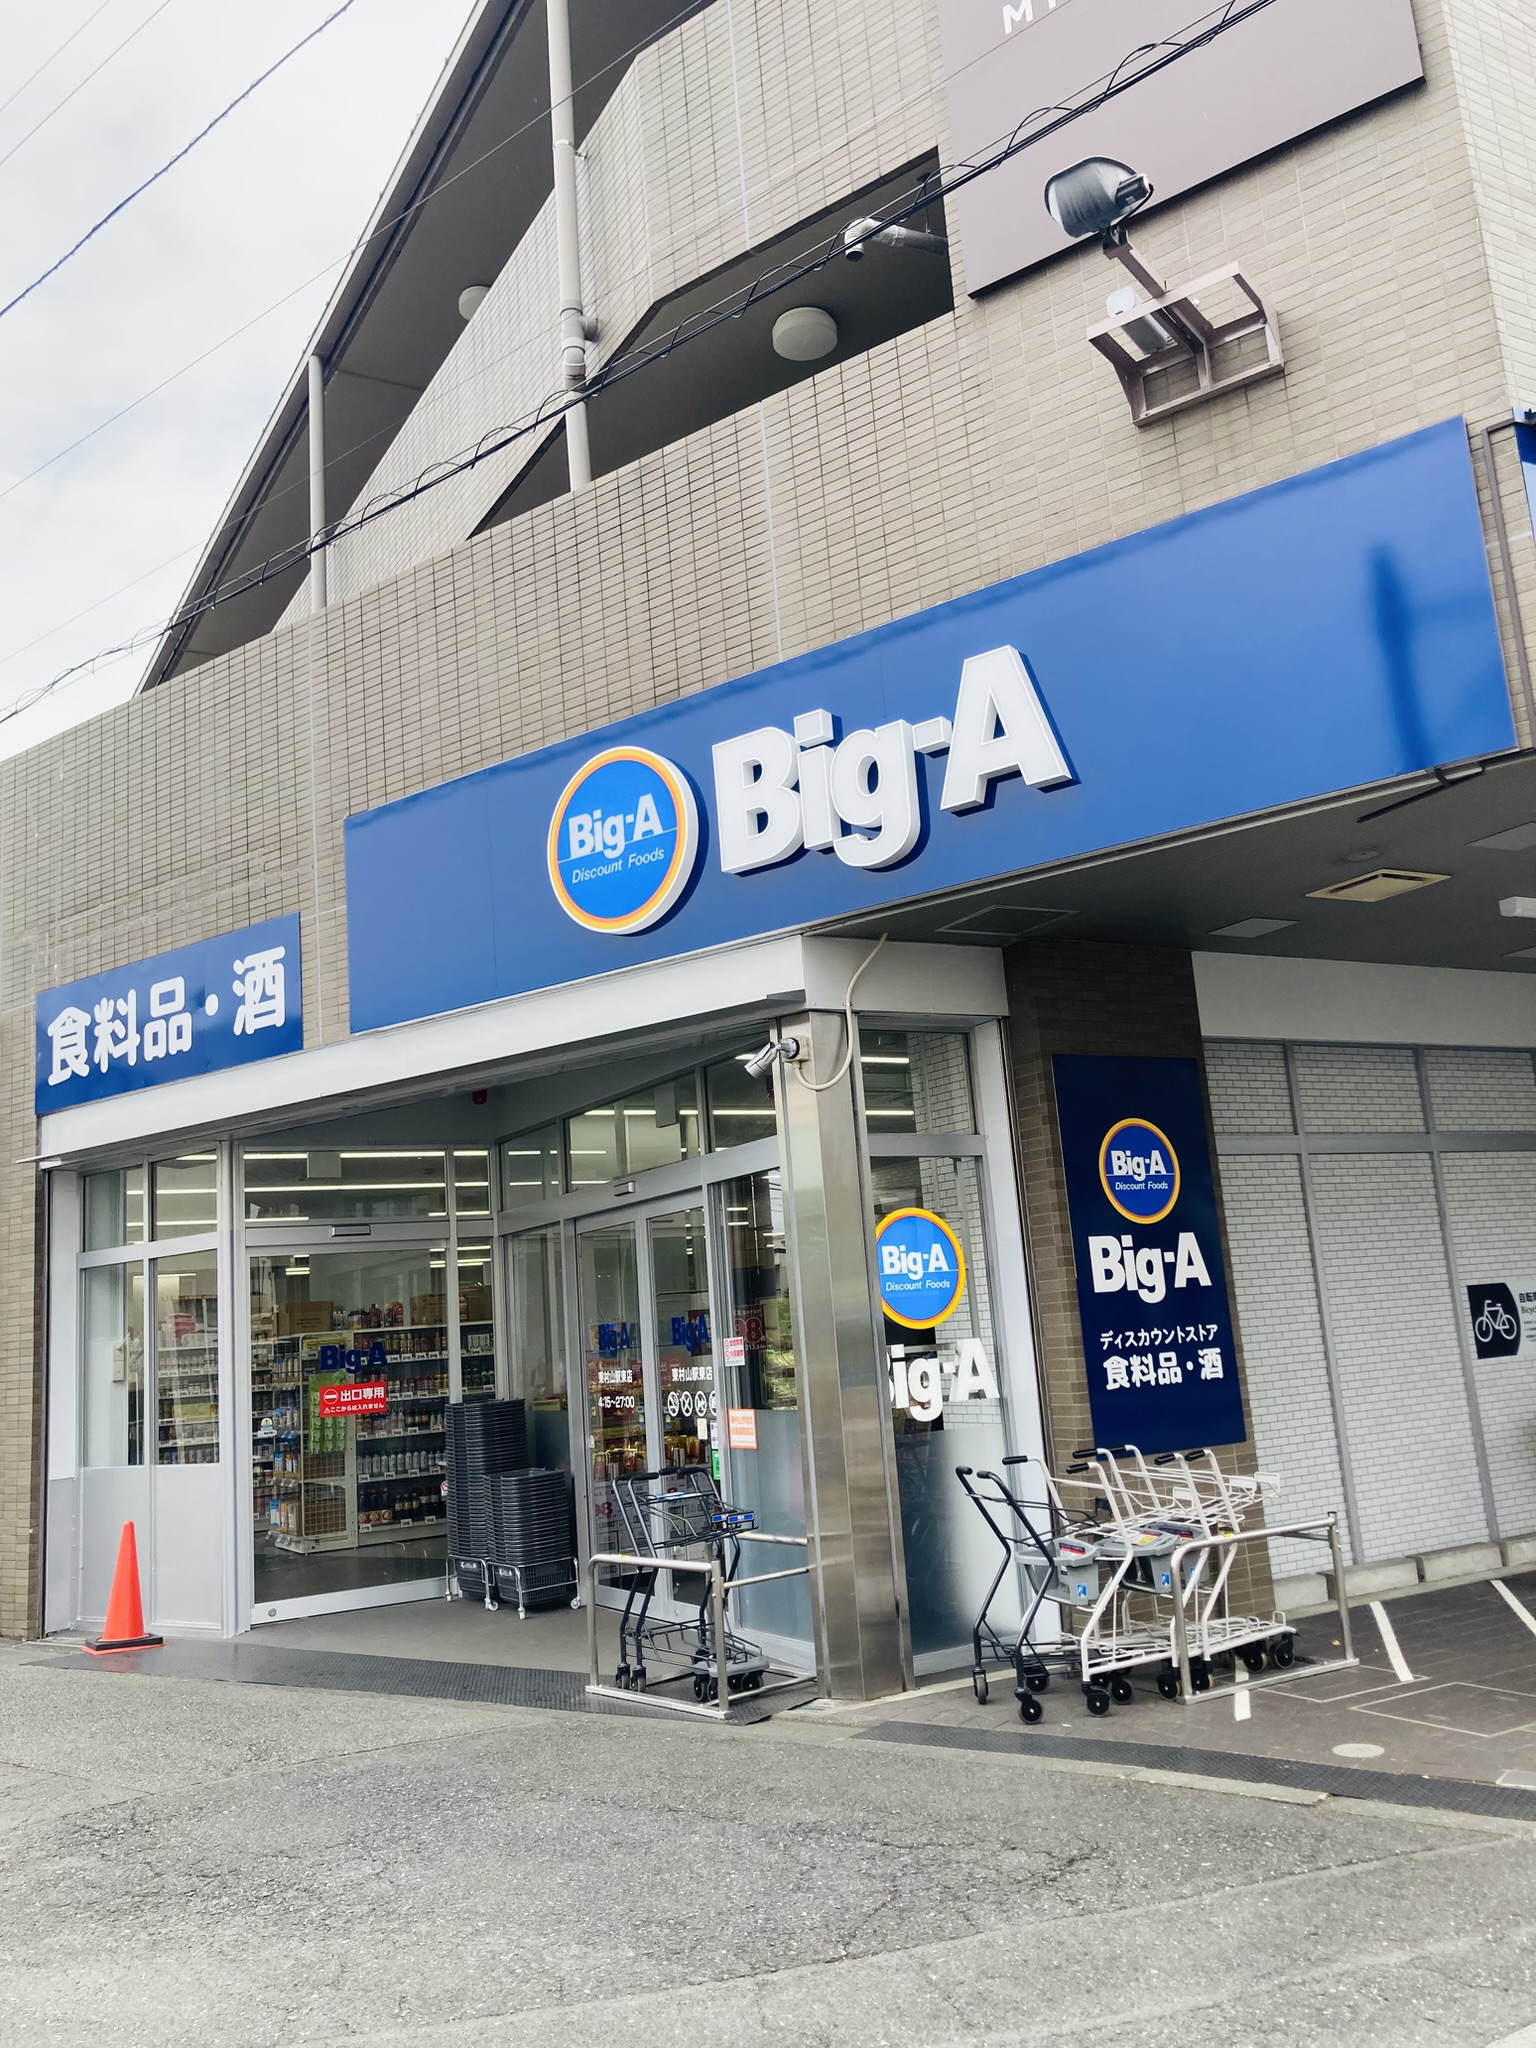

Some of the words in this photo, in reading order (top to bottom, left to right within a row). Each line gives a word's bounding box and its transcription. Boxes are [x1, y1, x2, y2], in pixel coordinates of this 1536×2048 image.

[1002, 0, 1057, 35] M
[711, 644, 1073, 875] Big-A
[568, 793, 664, 859] Big-A
[572, 859, 623, 884] Discount
[628, 847, 665, 868] Foods
[47, 945, 286, 1087] 食料品・酒
[1110, 1150, 1168, 1181] Big-A
[1115, 1181, 1145, 1191] Discount
[1147, 1180, 1169, 1190] Foods
[881, 1243, 950, 1280] Big-A
[1088, 1231, 1212, 1304] Big-A
[885, 1281, 922, 1292] Discount
[925, 1278, 951, 1289] Foods
[1100, 1324, 1219, 1350] ディスカウントストア
[320, 1341, 388, 1375] Big-A
[1103, 1347, 1225, 1390] 食料品・酒
[340, 1386, 385, 1402] 出口専用
[886, 1338, 1000, 1422] ig-A
